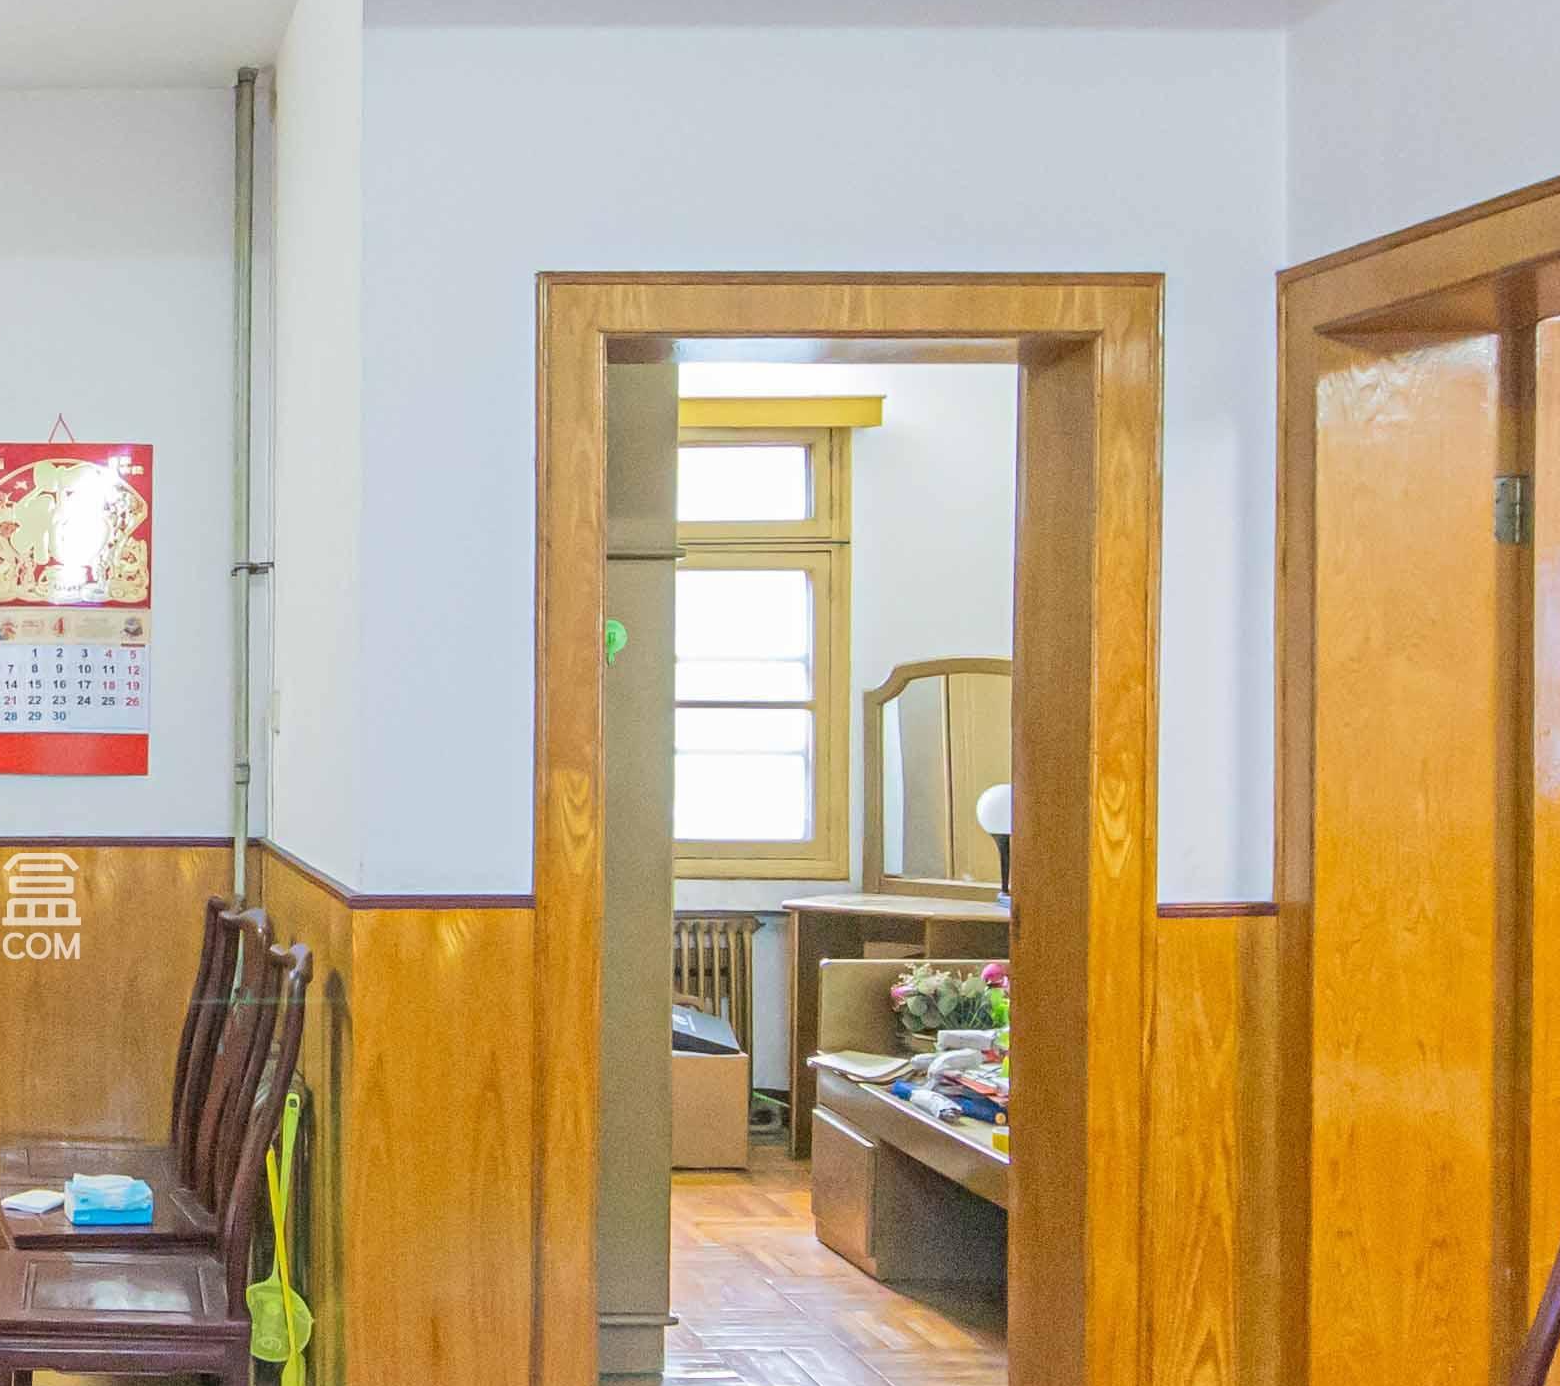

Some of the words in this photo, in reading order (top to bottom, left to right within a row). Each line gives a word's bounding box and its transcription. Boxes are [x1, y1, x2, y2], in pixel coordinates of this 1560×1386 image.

[53, 617, 65, 635] 4
[78, 664, 92, 674] 10
[102, 665, 115, 674] 11
[127, 665, 140, 676] 12
[5, 680, 18, 690] 14
[29, 679, 42, 689] 15
[53, 679, 67, 689] 16
[77, 679, 92, 690] 17
[102, 680, 116, 691] 18
[125, 681, 140, 691] 19
[3, 695, 17, 706] 21
[28, 695, 42, 705] 22
[52, 695, 67, 706] 23
[77, 695, 91, 706] 24
[101, 696, 116, 706] 25
[125, 696, 140, 707] 26
[4, 711, 18, 722] 28
[28, 711, 43, 722] 29
[53, 711, 67, 722] 30
